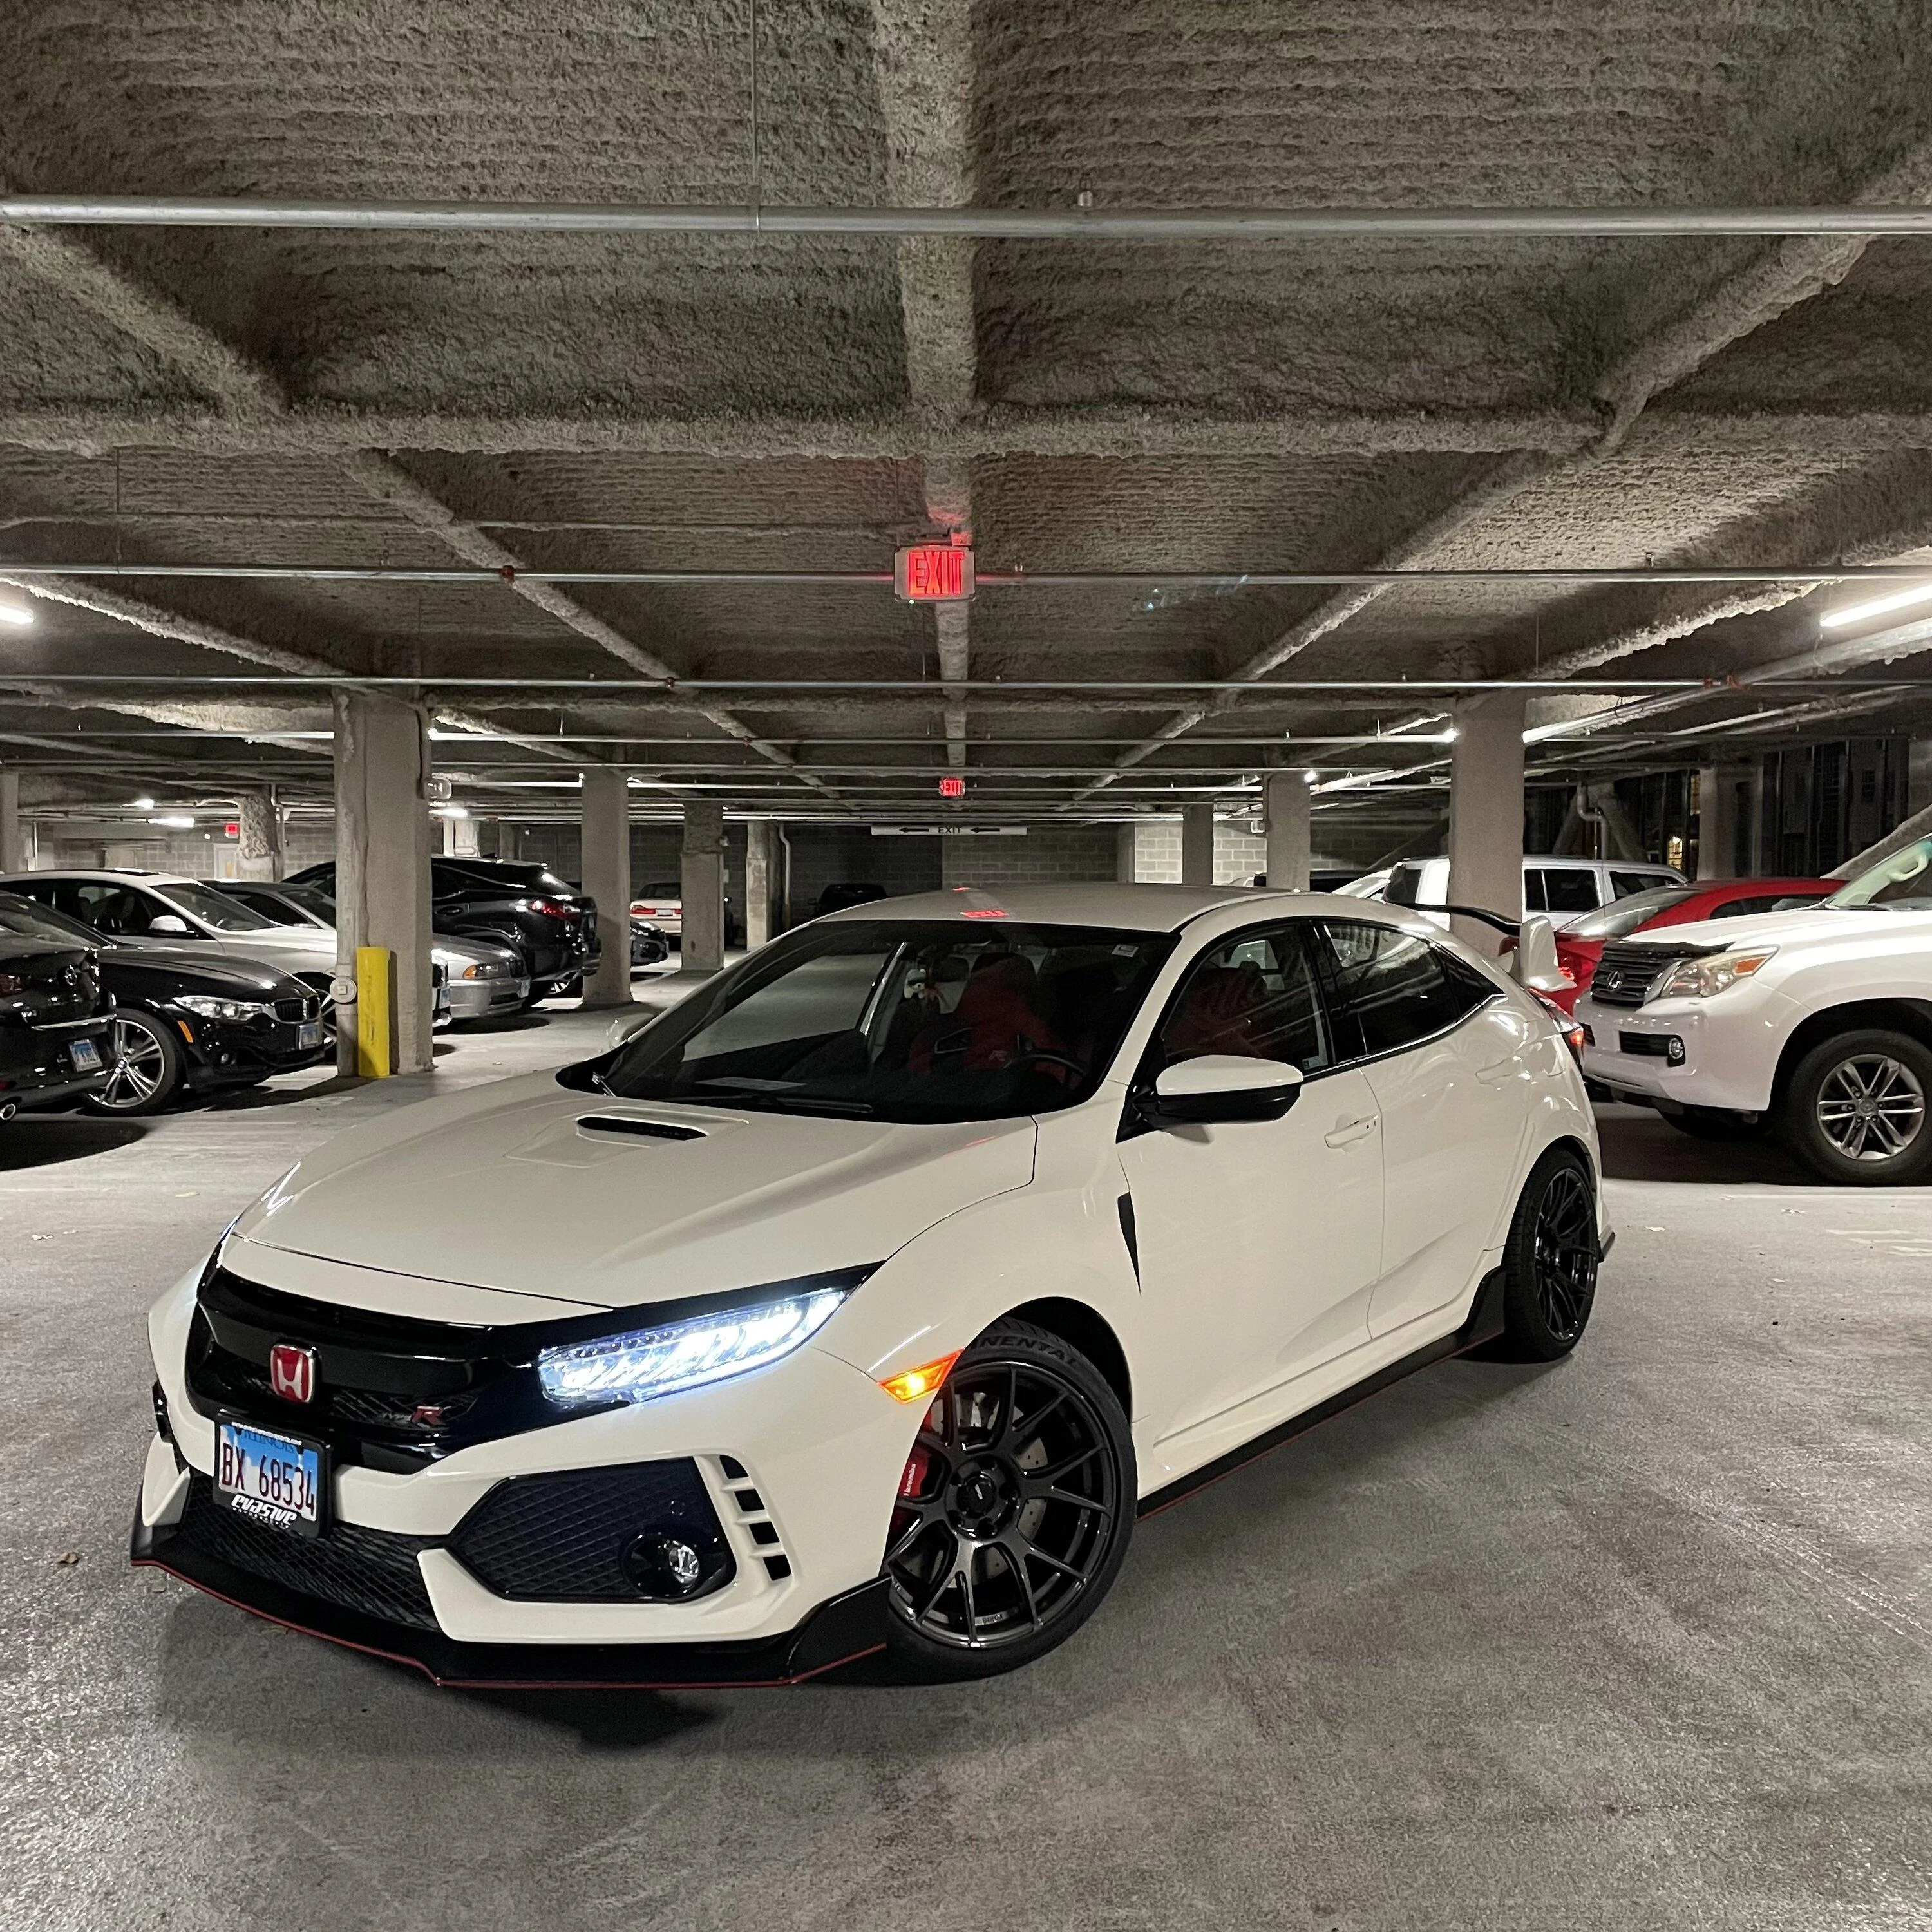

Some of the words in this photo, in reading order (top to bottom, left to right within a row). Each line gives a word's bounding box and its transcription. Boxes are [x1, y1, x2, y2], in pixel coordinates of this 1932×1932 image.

[909, 551, 964, 594] EXIT
[943, 779, 963, 795] EXIT
[222, 1443, 245, 1490] BX
[259, 1455, 314, 1516] 68534
